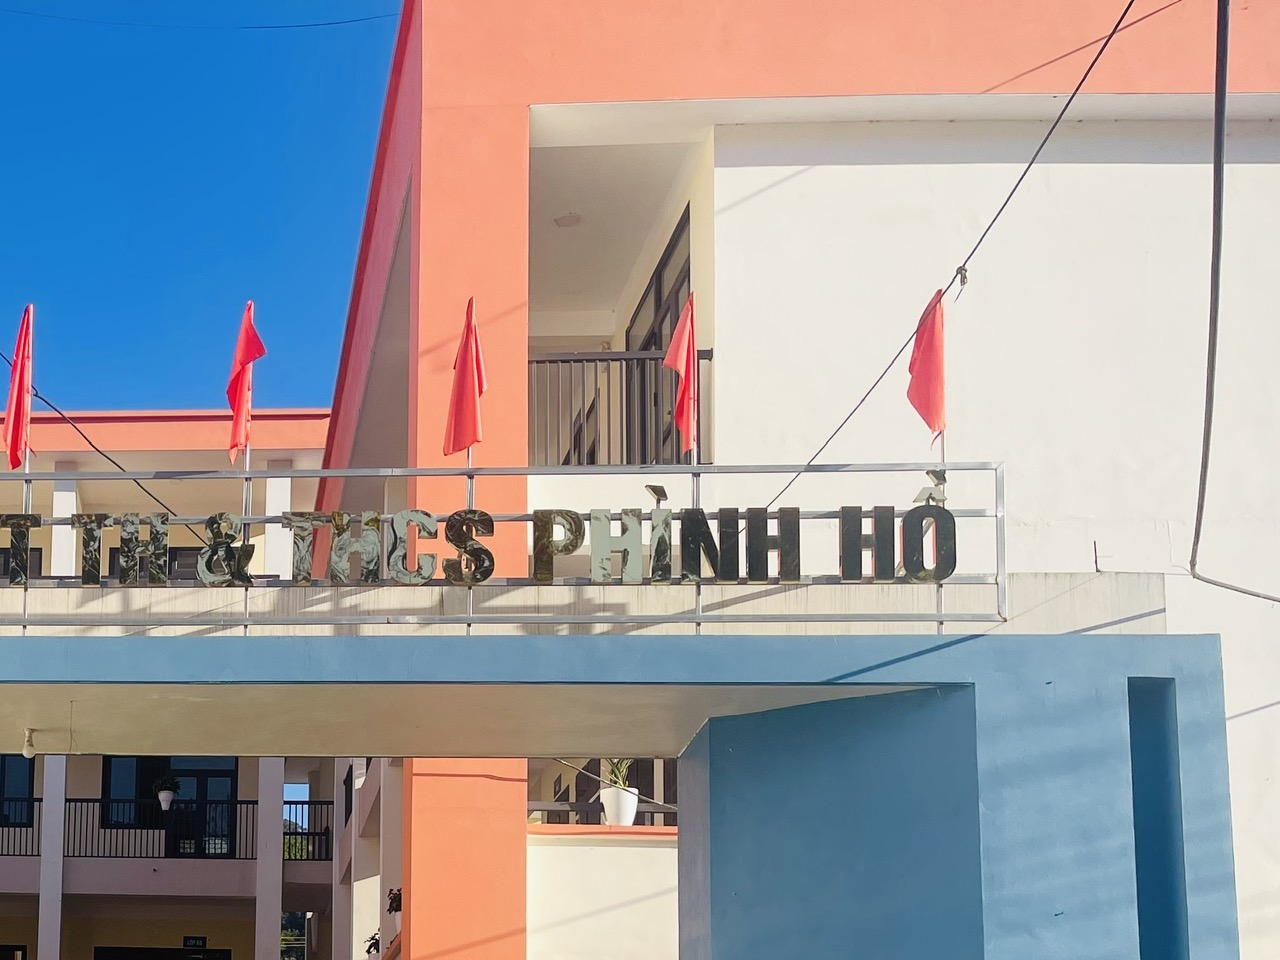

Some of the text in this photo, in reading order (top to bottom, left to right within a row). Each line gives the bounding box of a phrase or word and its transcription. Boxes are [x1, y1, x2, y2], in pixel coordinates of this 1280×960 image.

[71, 511, 170, 587] TH
[197, 511, 256, 587] &
[282, 509, 495, 587] THCS
[532, 483, 801, 584] PHÌNH
[839, 469, 958, 583] HỒ
